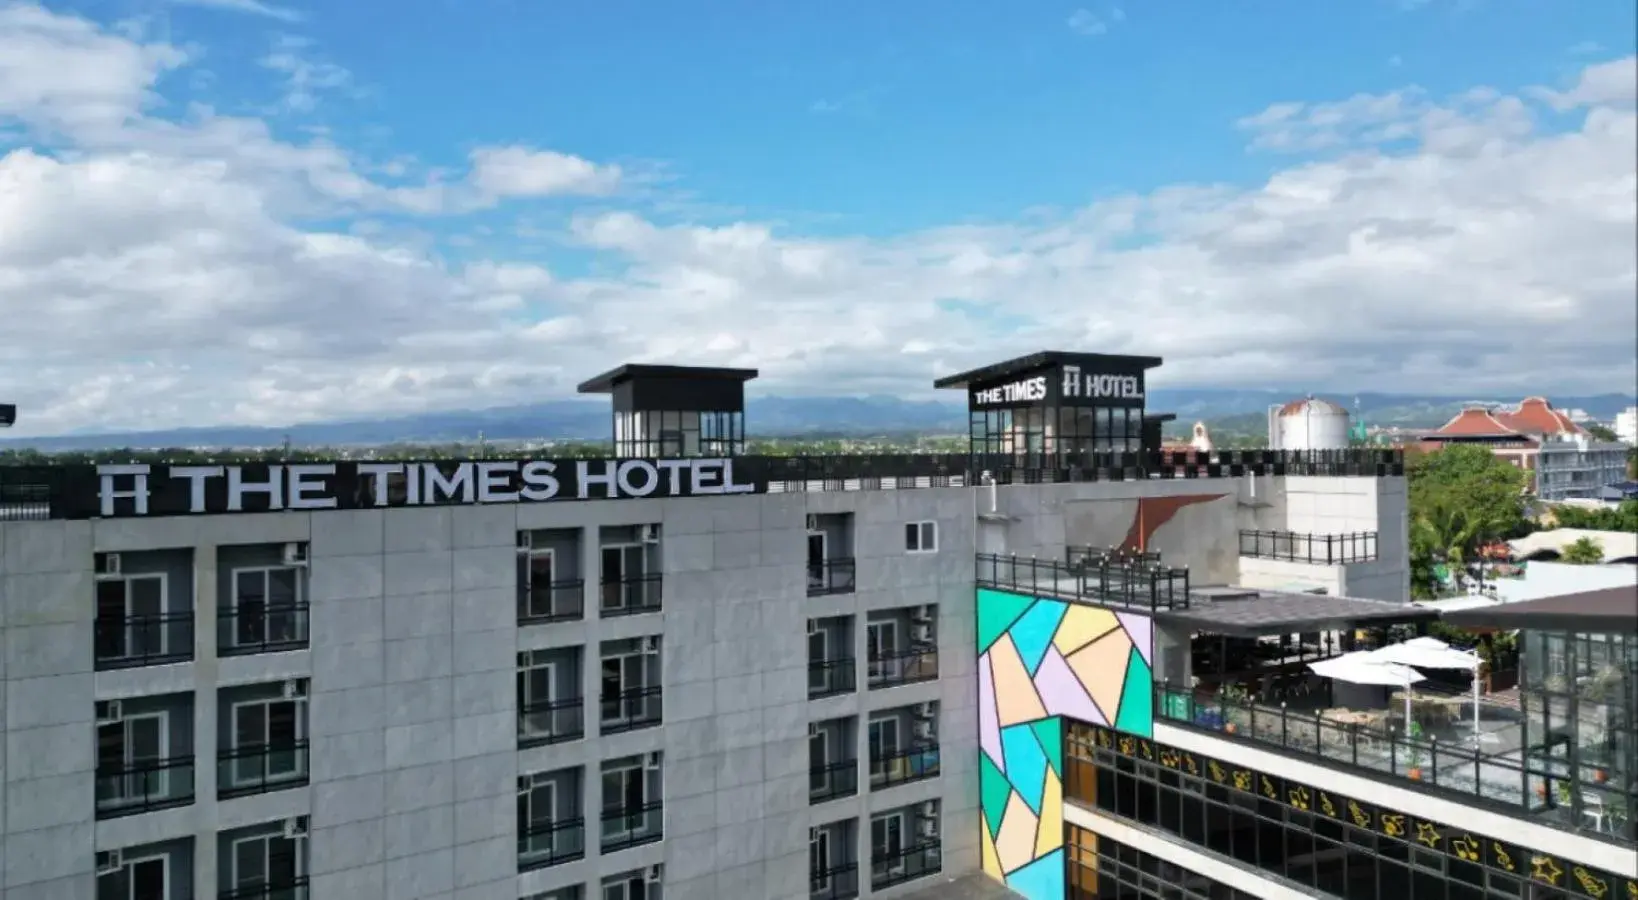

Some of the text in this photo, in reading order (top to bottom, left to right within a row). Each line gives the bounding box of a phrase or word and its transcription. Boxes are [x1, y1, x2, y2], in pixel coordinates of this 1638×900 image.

[974, 376, 1047, 404] THE TIMES
[1085, 374, 1144, 398] HOTEL
[169, 457, 755, 512] THE TIMES HOTEL
